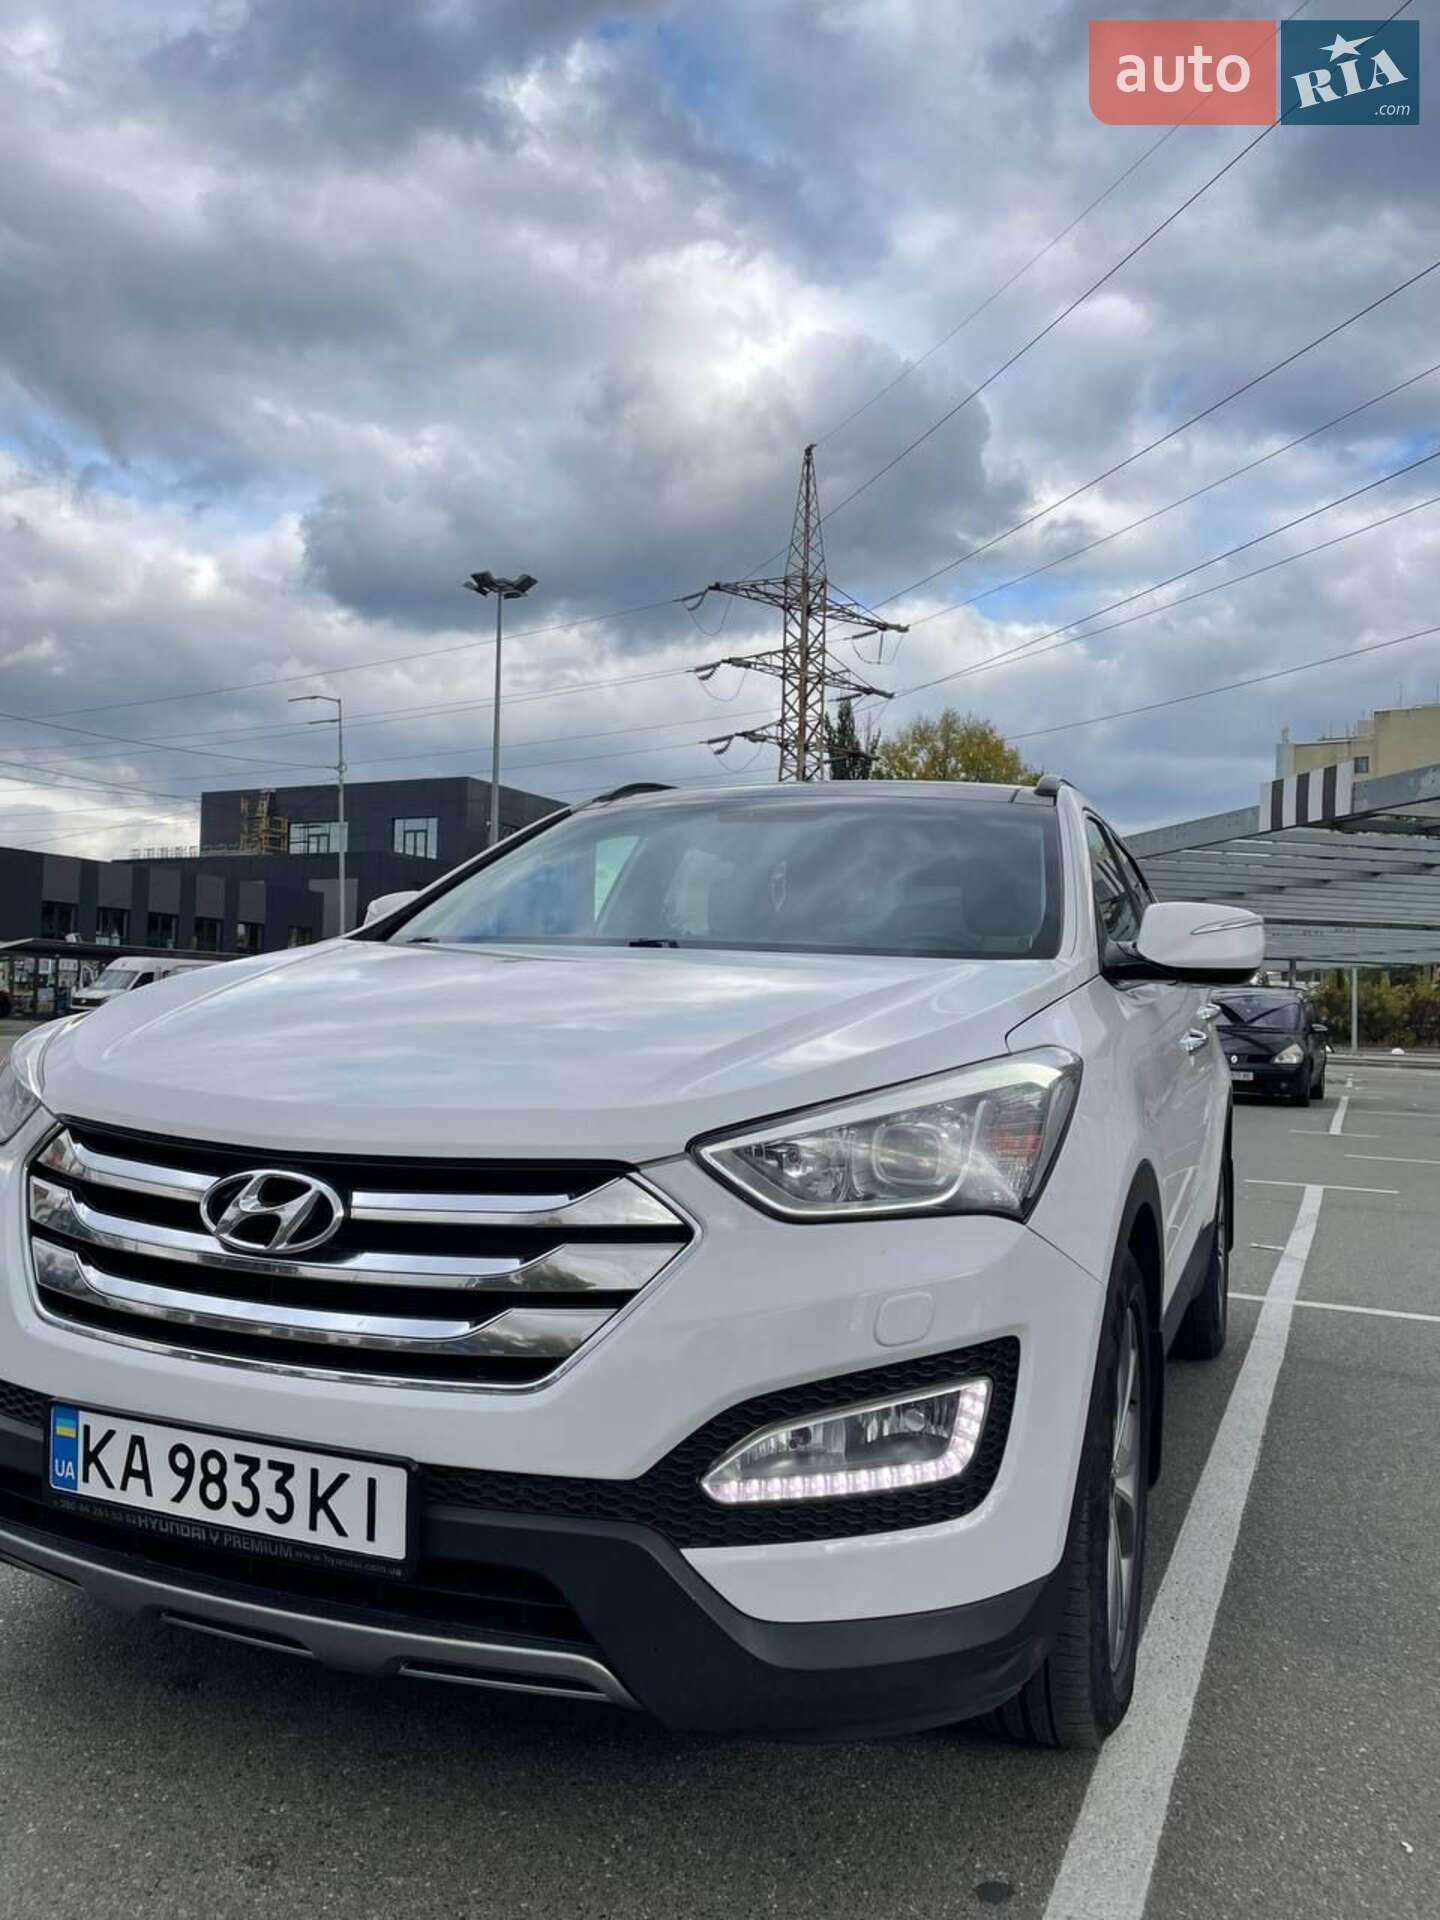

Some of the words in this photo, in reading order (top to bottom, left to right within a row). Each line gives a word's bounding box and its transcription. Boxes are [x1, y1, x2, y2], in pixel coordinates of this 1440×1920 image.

[55, 1458, 75, 1480] UA
[82, 1424, 153, 1497] KA
[167, 1442, 295, 1525] 9833
[308, 1467, 378, 1542] KI
[138, 1515, 205, 1541] HYUNDAI
[224, 1533, 292, 1560] PREMIUM
